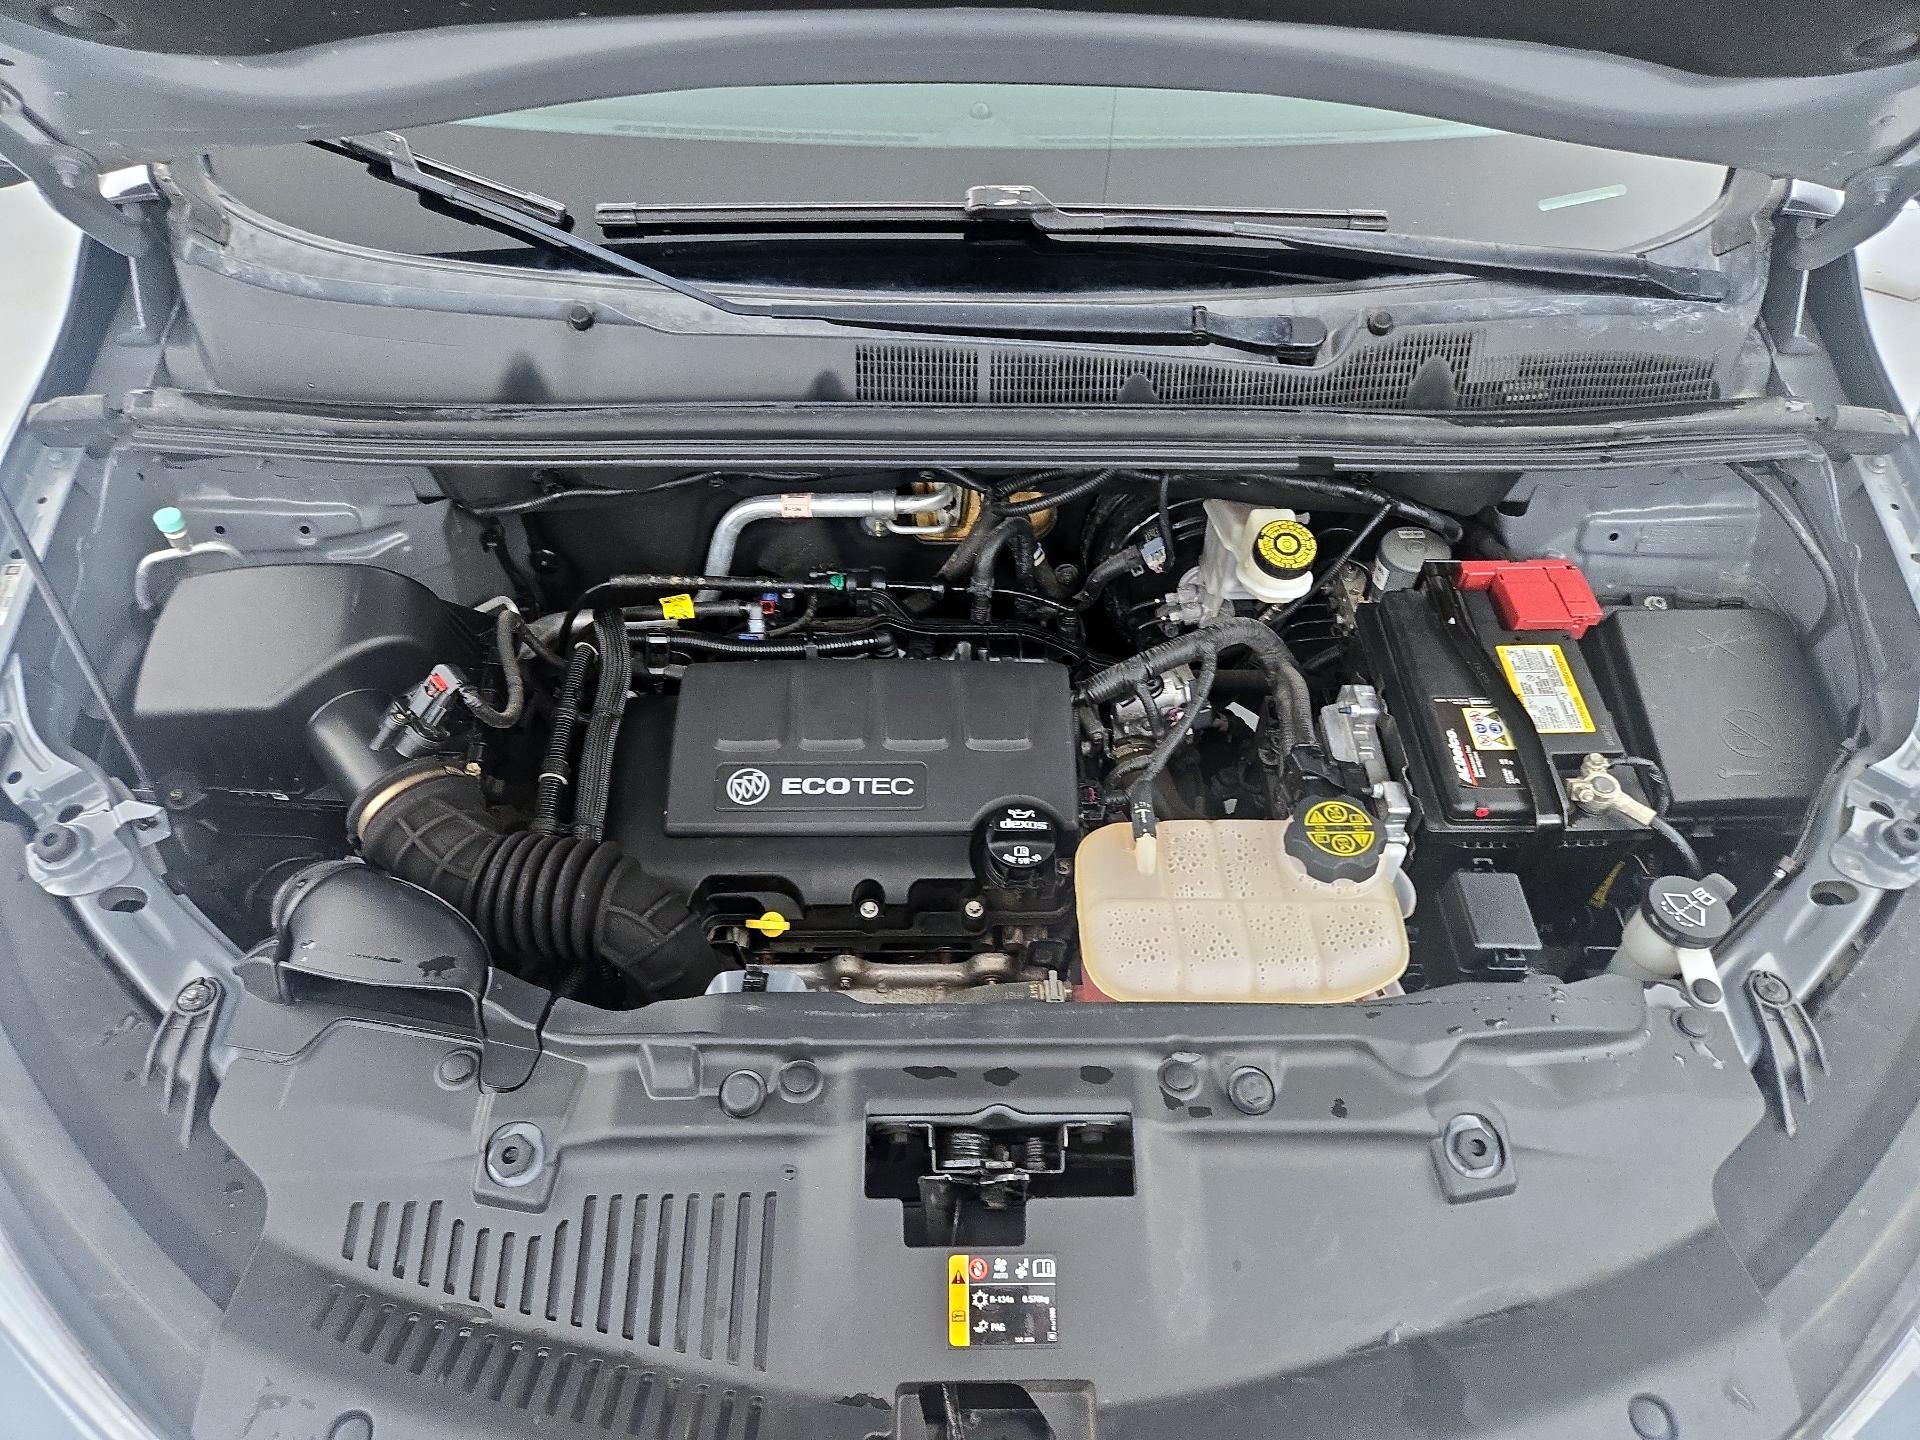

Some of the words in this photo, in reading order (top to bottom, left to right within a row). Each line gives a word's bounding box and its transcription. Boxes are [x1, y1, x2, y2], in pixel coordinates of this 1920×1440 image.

[781, 777, 915, 796] ECOTEC
[999, 818, 1048, 830] dexos
[990, 1322, 1006, 1331] PAG
